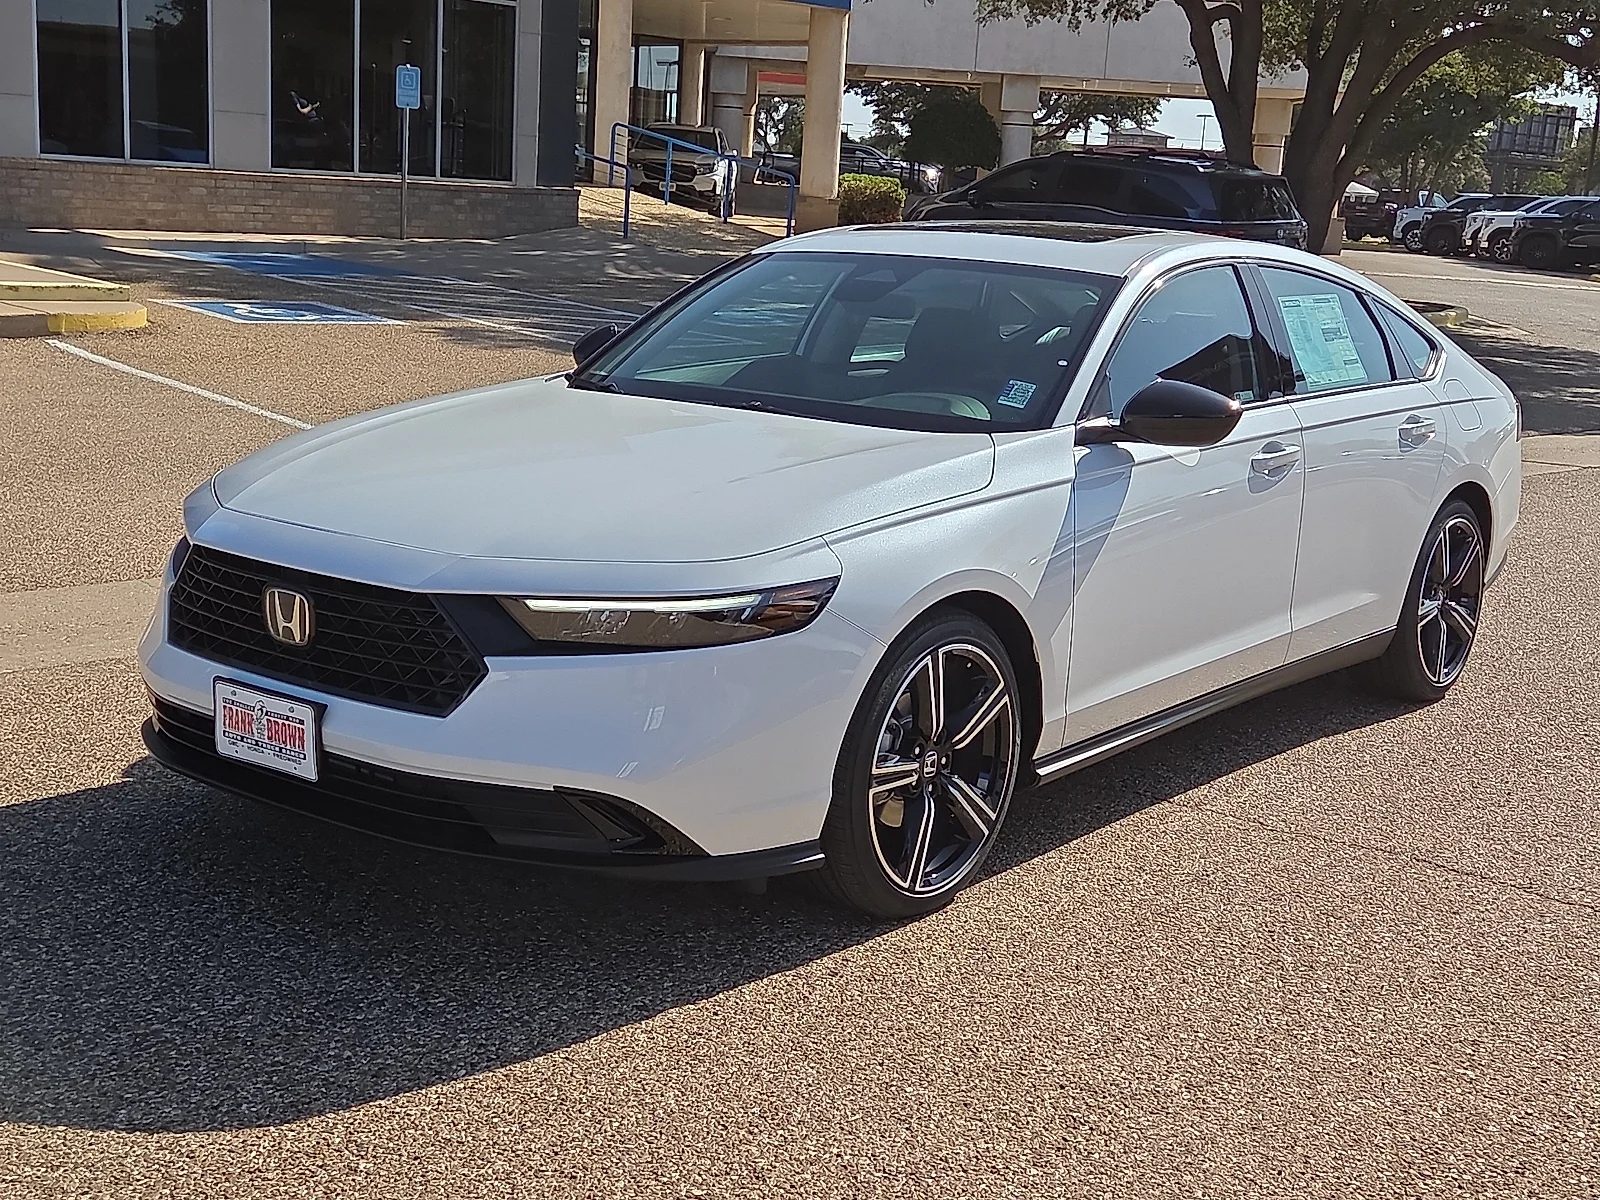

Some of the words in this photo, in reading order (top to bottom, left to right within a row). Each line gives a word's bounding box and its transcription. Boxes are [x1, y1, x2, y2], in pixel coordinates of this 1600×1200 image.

[223, 705, 254, 736] FRANK
[266, 719, 305, 752] BROWN
[225, 732, 241, 740] AUTO
